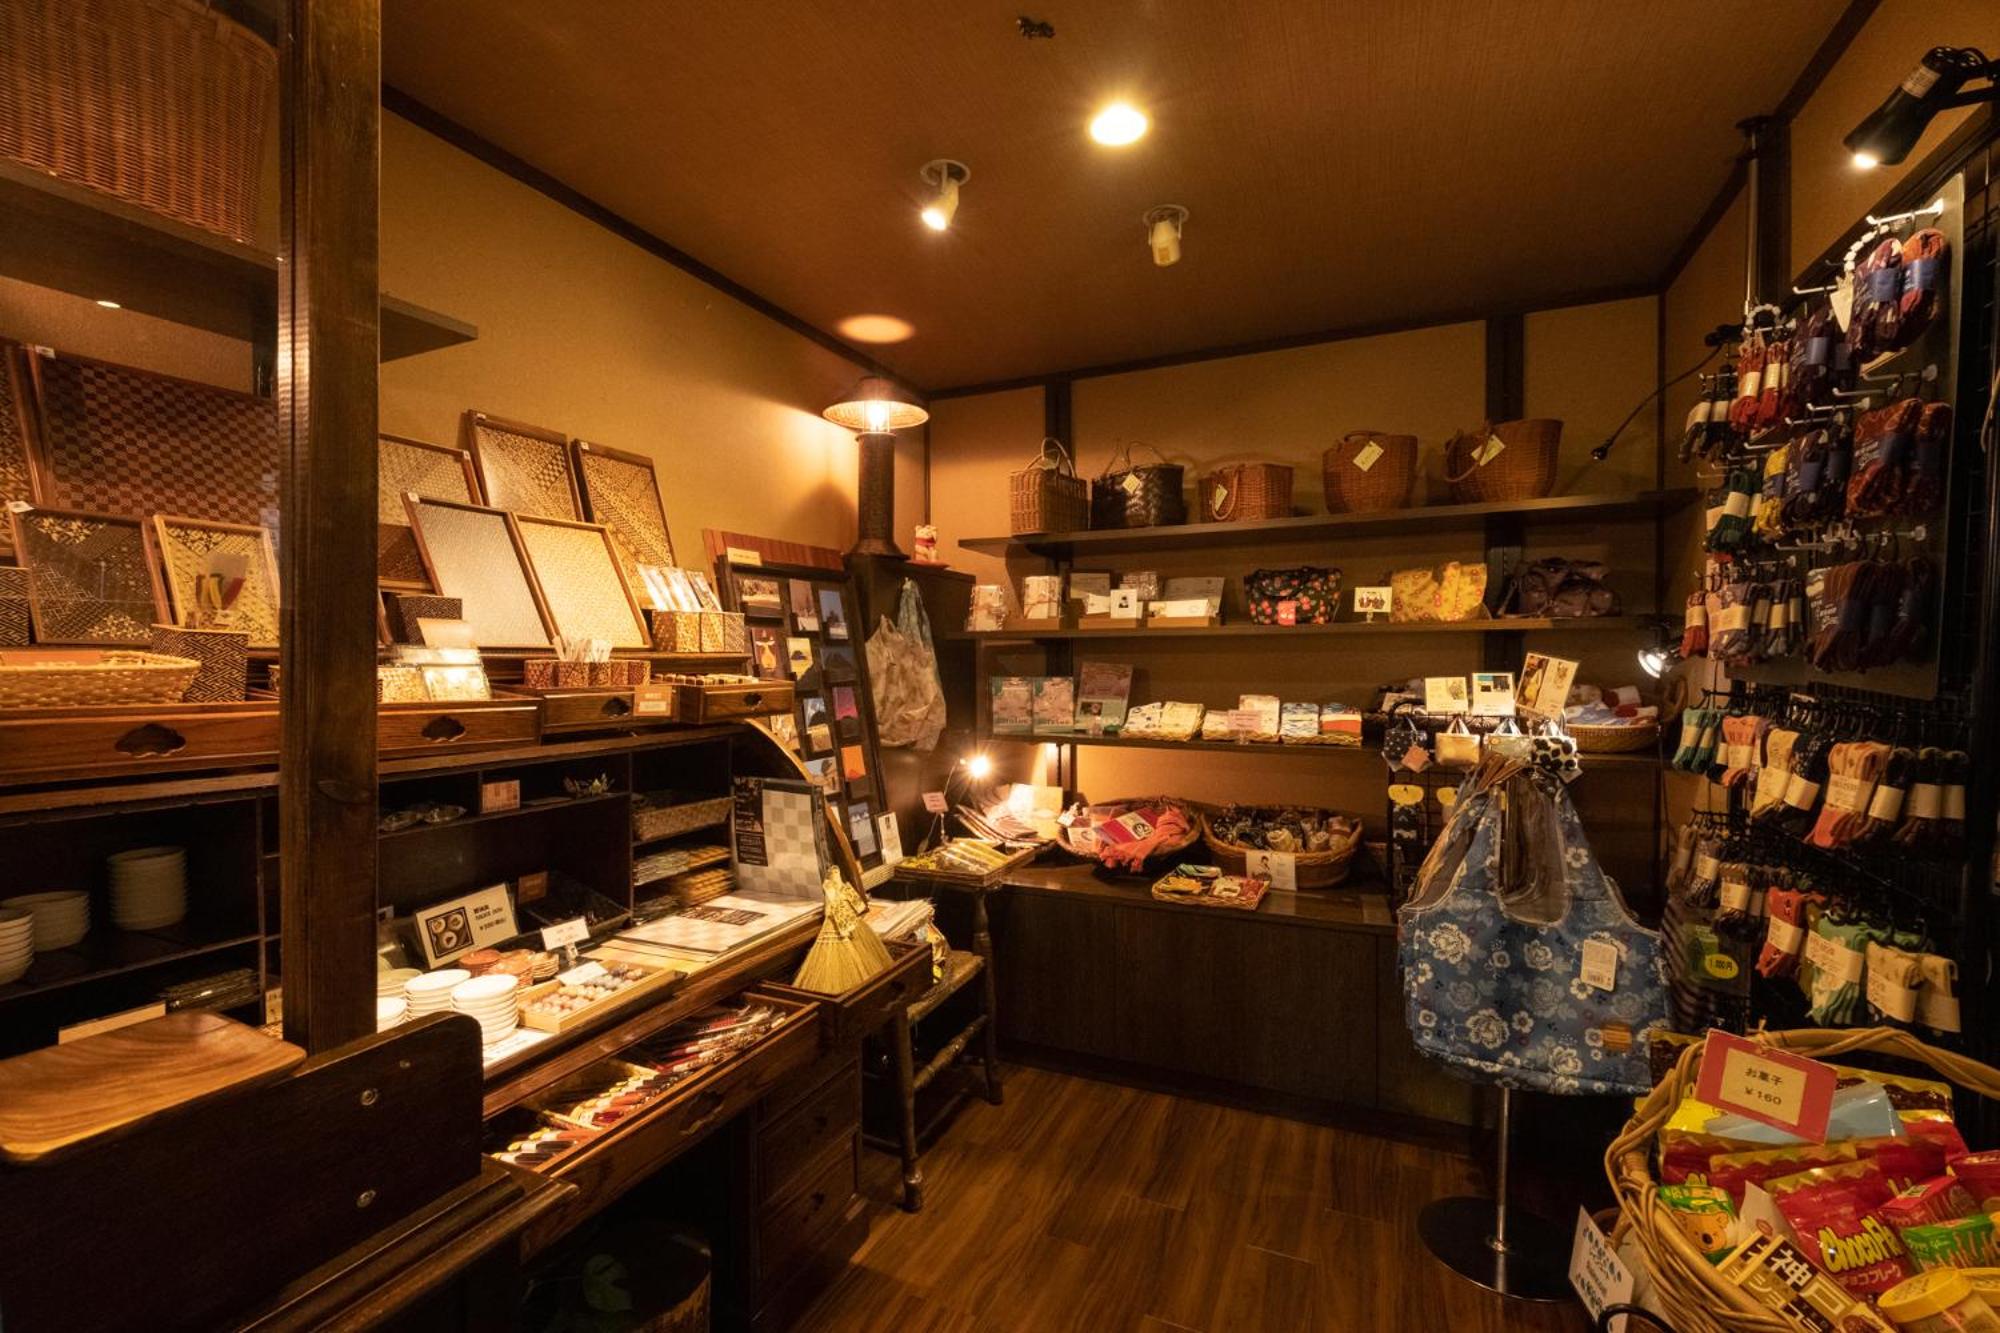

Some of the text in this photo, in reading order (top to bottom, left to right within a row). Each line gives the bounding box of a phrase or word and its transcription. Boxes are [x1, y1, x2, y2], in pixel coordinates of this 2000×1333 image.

[1744, 1067, 1783, 1087] お菓子
[1769, 1247, 1856, 1316] 神戸
